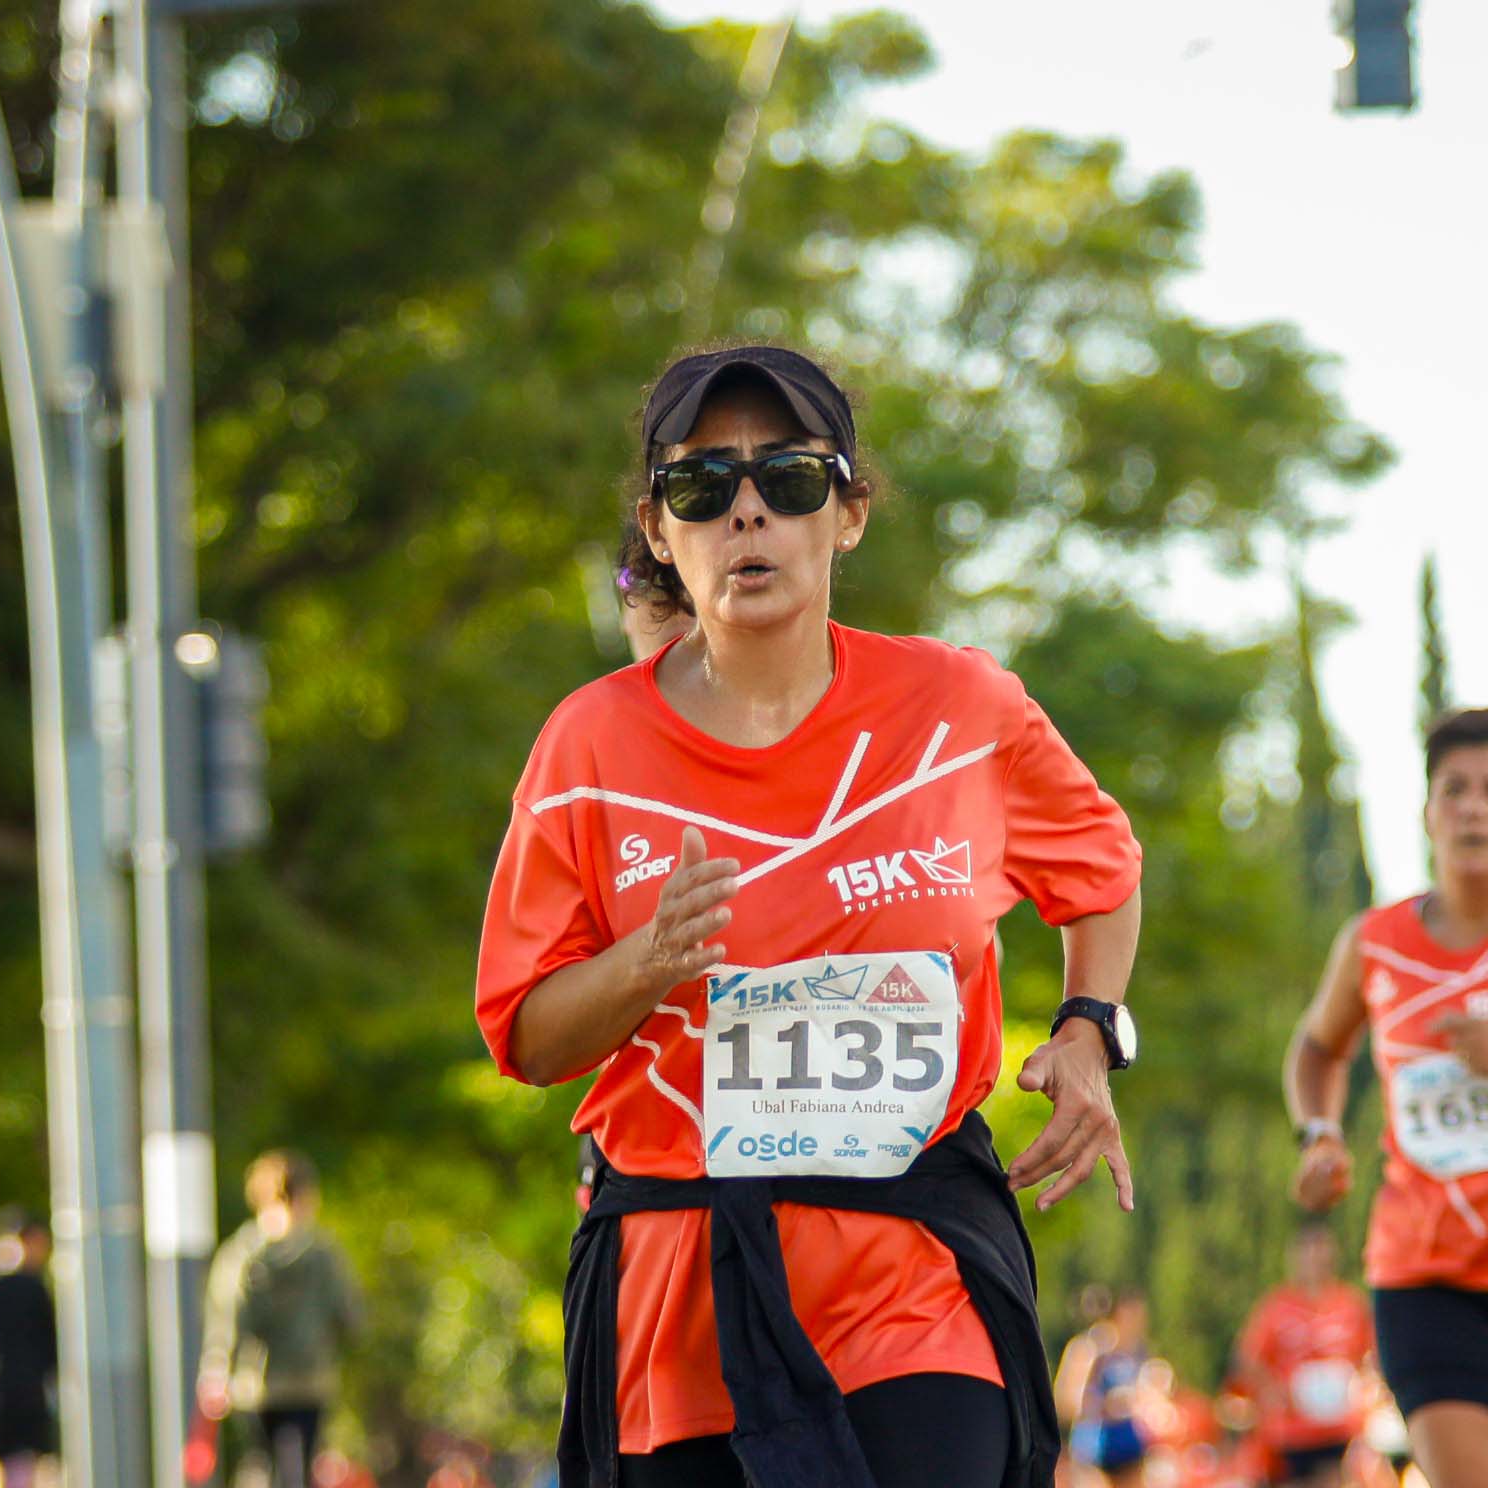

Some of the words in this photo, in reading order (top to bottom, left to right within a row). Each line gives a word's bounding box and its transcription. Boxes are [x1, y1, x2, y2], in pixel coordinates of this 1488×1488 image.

[827, 851, 917, 903] 15K
[844, 889, 920, 915] PUERTO
[927, 887, 975, 897] NORTE
[733, 978, 798, 1010] 15K
[879, 981, 914, 998] 15K
[717, 1019, 945, 1092] 1135
[751, 1100, 785, 1114] Ubal
[790, 1099, 847, 1114] Fabiana
[851, 1100, 905, 1114] Andrea
[737, 1129, 818, 1162] osde
